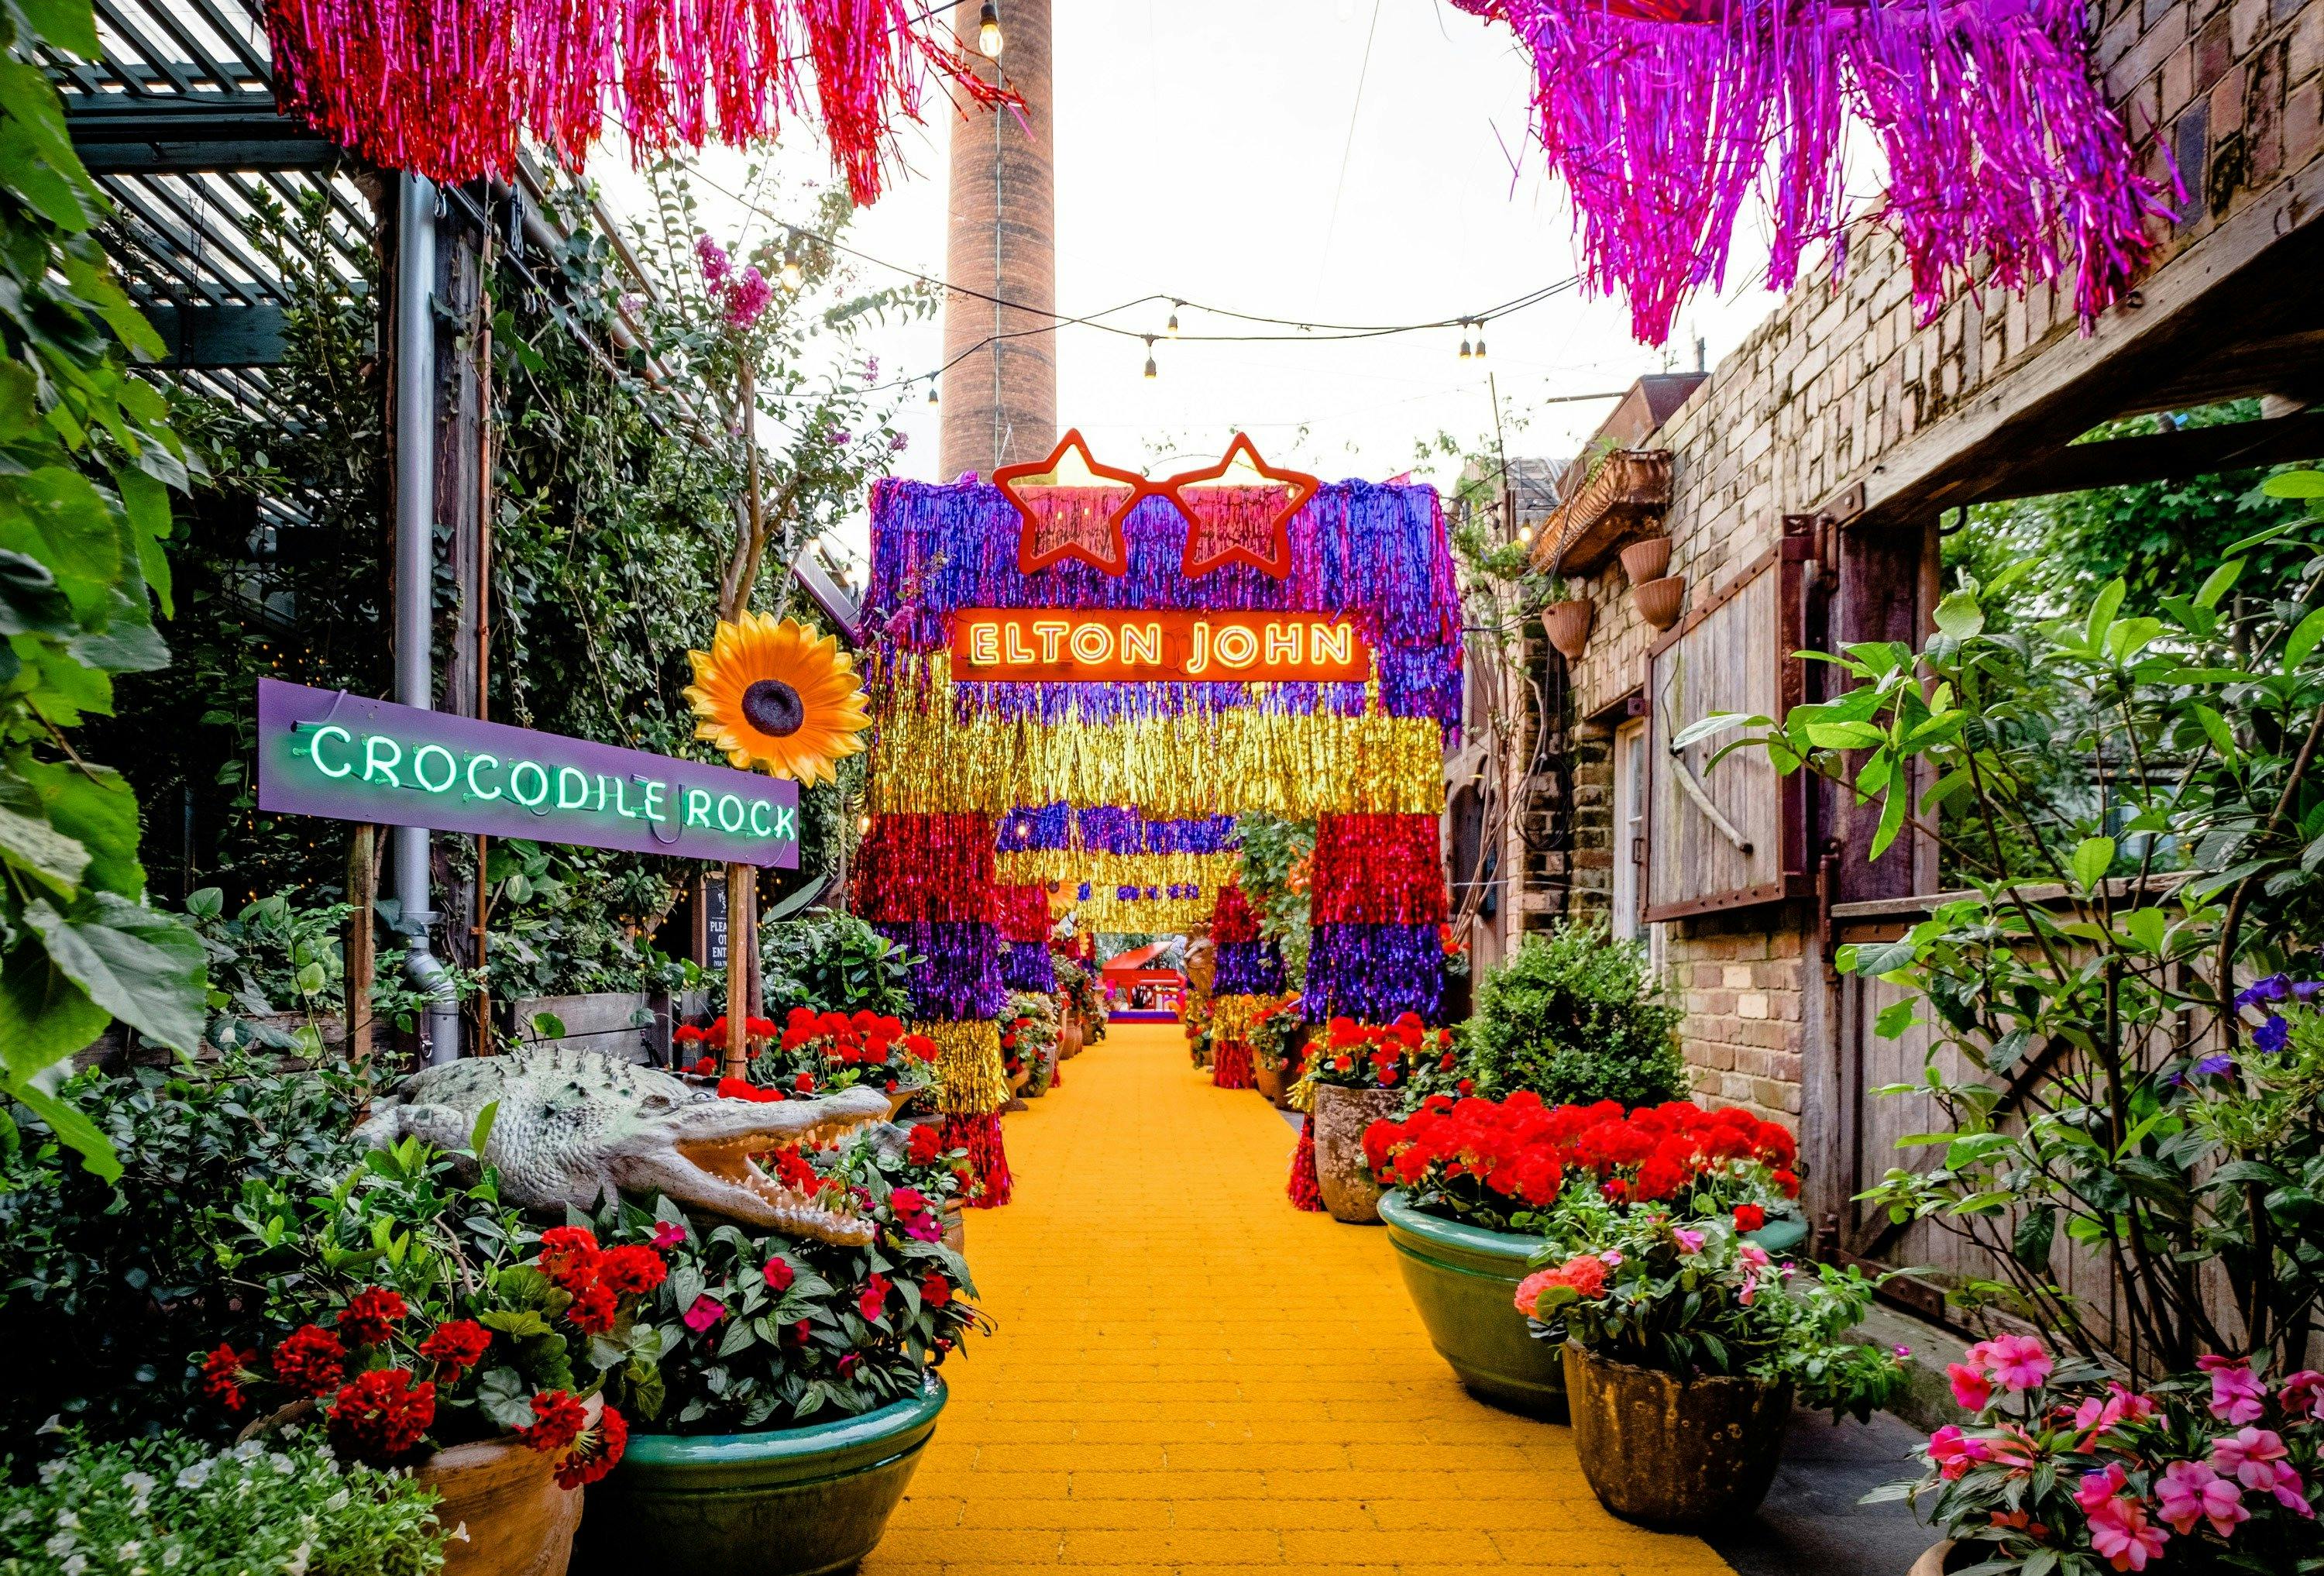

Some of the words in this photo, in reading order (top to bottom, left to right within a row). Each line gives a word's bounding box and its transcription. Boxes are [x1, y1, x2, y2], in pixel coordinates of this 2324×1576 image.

[970, 621, 1162, 666] ELTON
[1186, 621, 1354, 674] JOHN
[310, 724, 667, 822] CROCODILE
[686, 788, 797, 841] ROCK
[710, 920, 727, 932] PLEA
[712, 946, 727, 958] ENT
